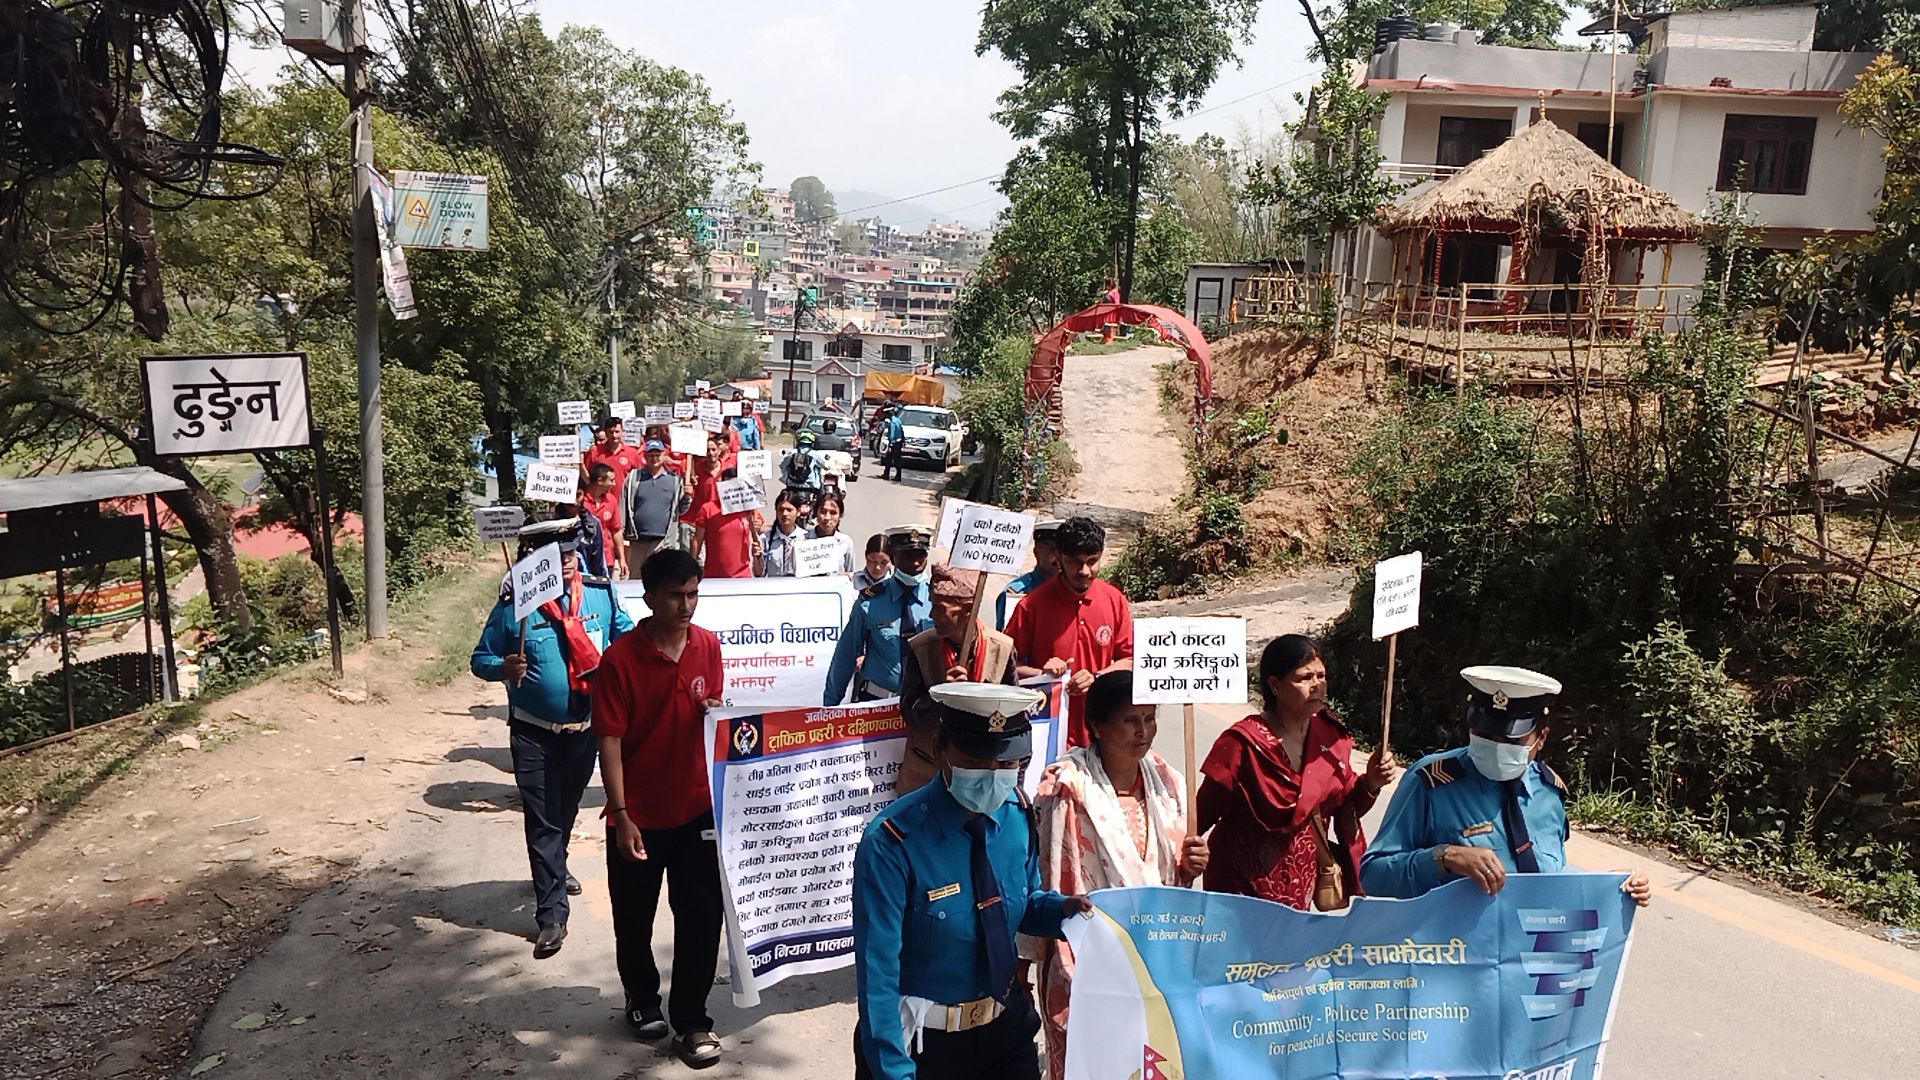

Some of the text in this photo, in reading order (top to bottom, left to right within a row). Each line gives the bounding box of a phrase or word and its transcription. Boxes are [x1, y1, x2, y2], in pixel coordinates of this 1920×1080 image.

[440, 201, 473, 209] SLOW
[440, 209, 475, 219] DOWN
[963, 533, 988, 546] प्रयोग
[982, 552, 1015, 565] HORN)
[780, 622, 840, 644] विद्यालय
[1148, 630, 1177, 647] बाटो
[1140, 653, 1167, 670] जेब्रा
[730, 675, 777, 693] भक्तपुर
[1148, 675, 1188, 692] प्रयोग
[768, 729, 807, 753] ट्राफिक
[809, 723, 835, 744] प्रहरी
[836, 725, 845, 739] र
[799, 778, 821, 791] प्रयोग
[743, 804, 781, 816] सडकमा
[822, 789, 845, 804] सवारी
[821, 845, 844, 858] प्रयोग
[775, 868, 797, 880] फोन
[800, 864, 826, 877] प्रयोग
[828, 860, 845, 872] गरी
[774, 942, 813, 960] नियम
[815, 936, 854, 953] पालना
[1361, 937, 1467, 966] साझेदारी
[1347, 979, 1391, 991] समाजका
[1393, 976, 1419, 990] लागि
[1232, 1014, 1314, 1040] Community
[1324, 1006, 1369, 1022] Police
[1375, 1002, 1470, 1022] Partnership
[1269, 1027, 1429, 1056] for peaceful & Secure Society
